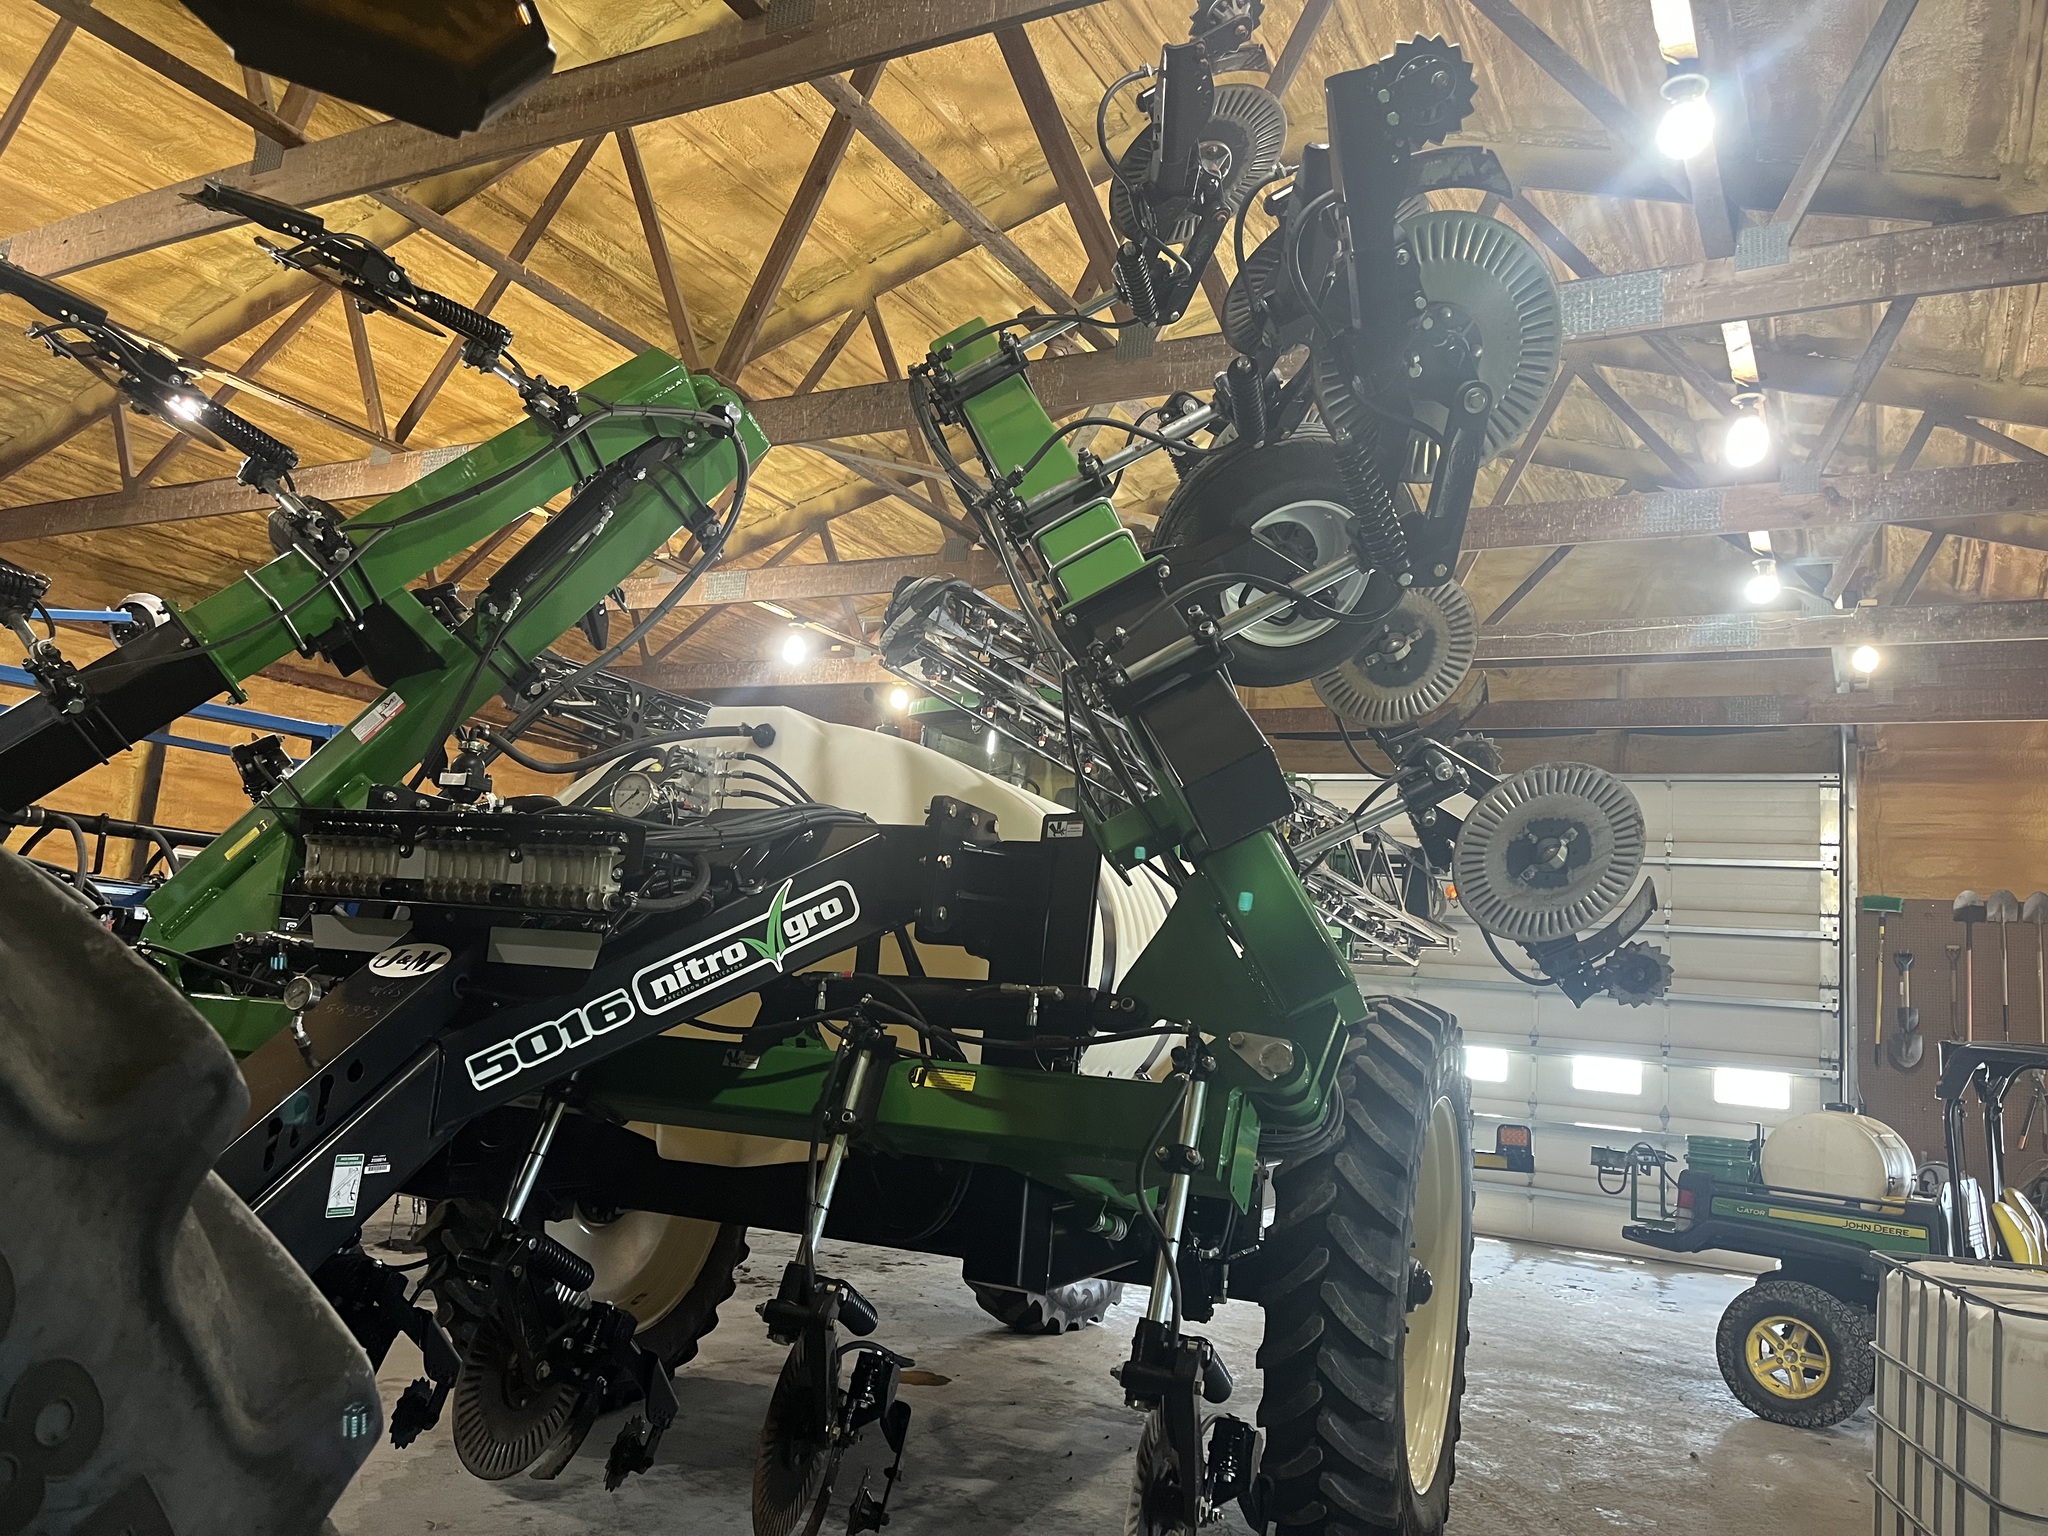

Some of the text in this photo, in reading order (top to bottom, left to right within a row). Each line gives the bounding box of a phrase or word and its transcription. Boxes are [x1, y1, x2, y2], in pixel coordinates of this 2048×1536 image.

[373, 948, 447, 972] J&M
[663, 963, 744, 1003] PRECISION APPLICATOR
[465, 987, 636, 1091] 5016
[1736, 1206, 1766, 1216] GATOR
[1842, 1220, 1909, 1237] JOHN DEERE
